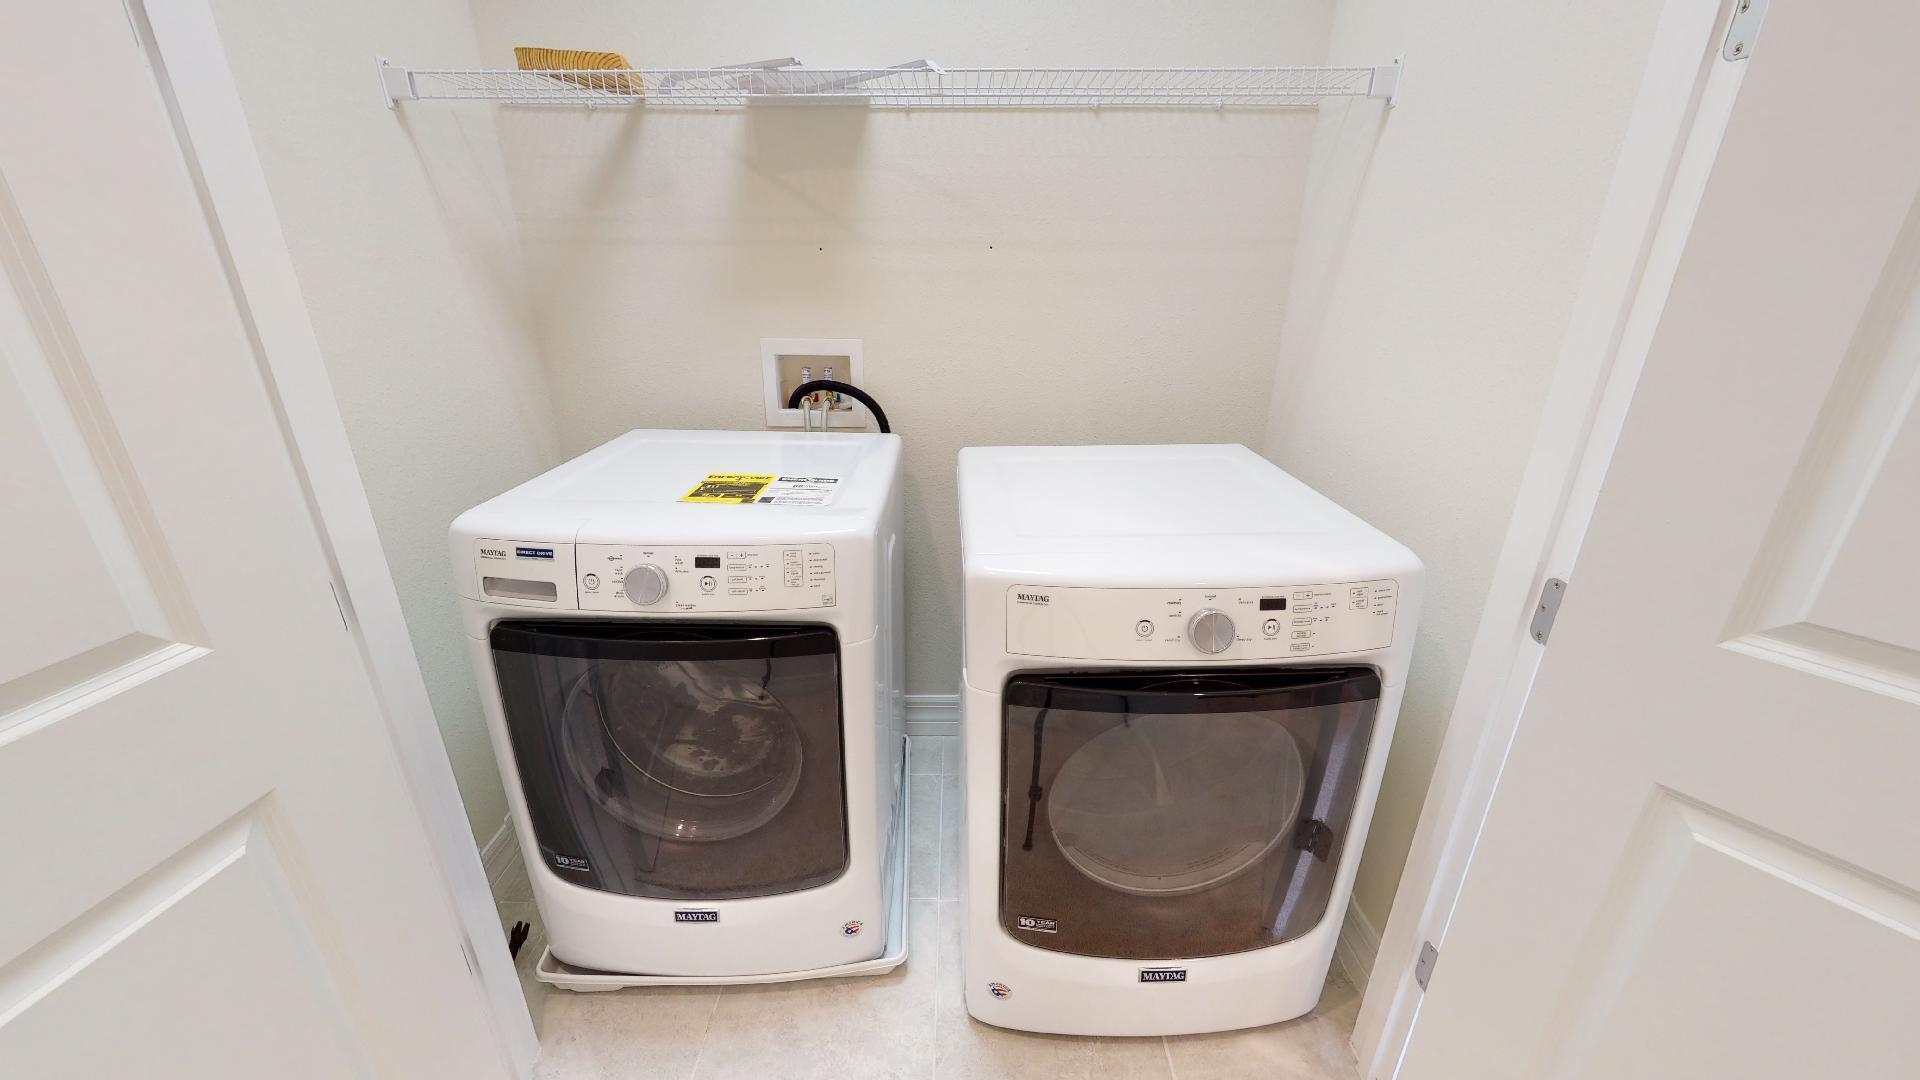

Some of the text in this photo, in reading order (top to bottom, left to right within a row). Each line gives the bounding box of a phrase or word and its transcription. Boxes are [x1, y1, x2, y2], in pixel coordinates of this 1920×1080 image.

[480, 548, 506, 557] MAYTAG
[1017, 593, 1050, 603] MAYTAG
[676, 913, 716, 921] MAYTAG
[1020, 918, 1036, 927] 10
[1142, 972, 1185, 981] MAYTAG
